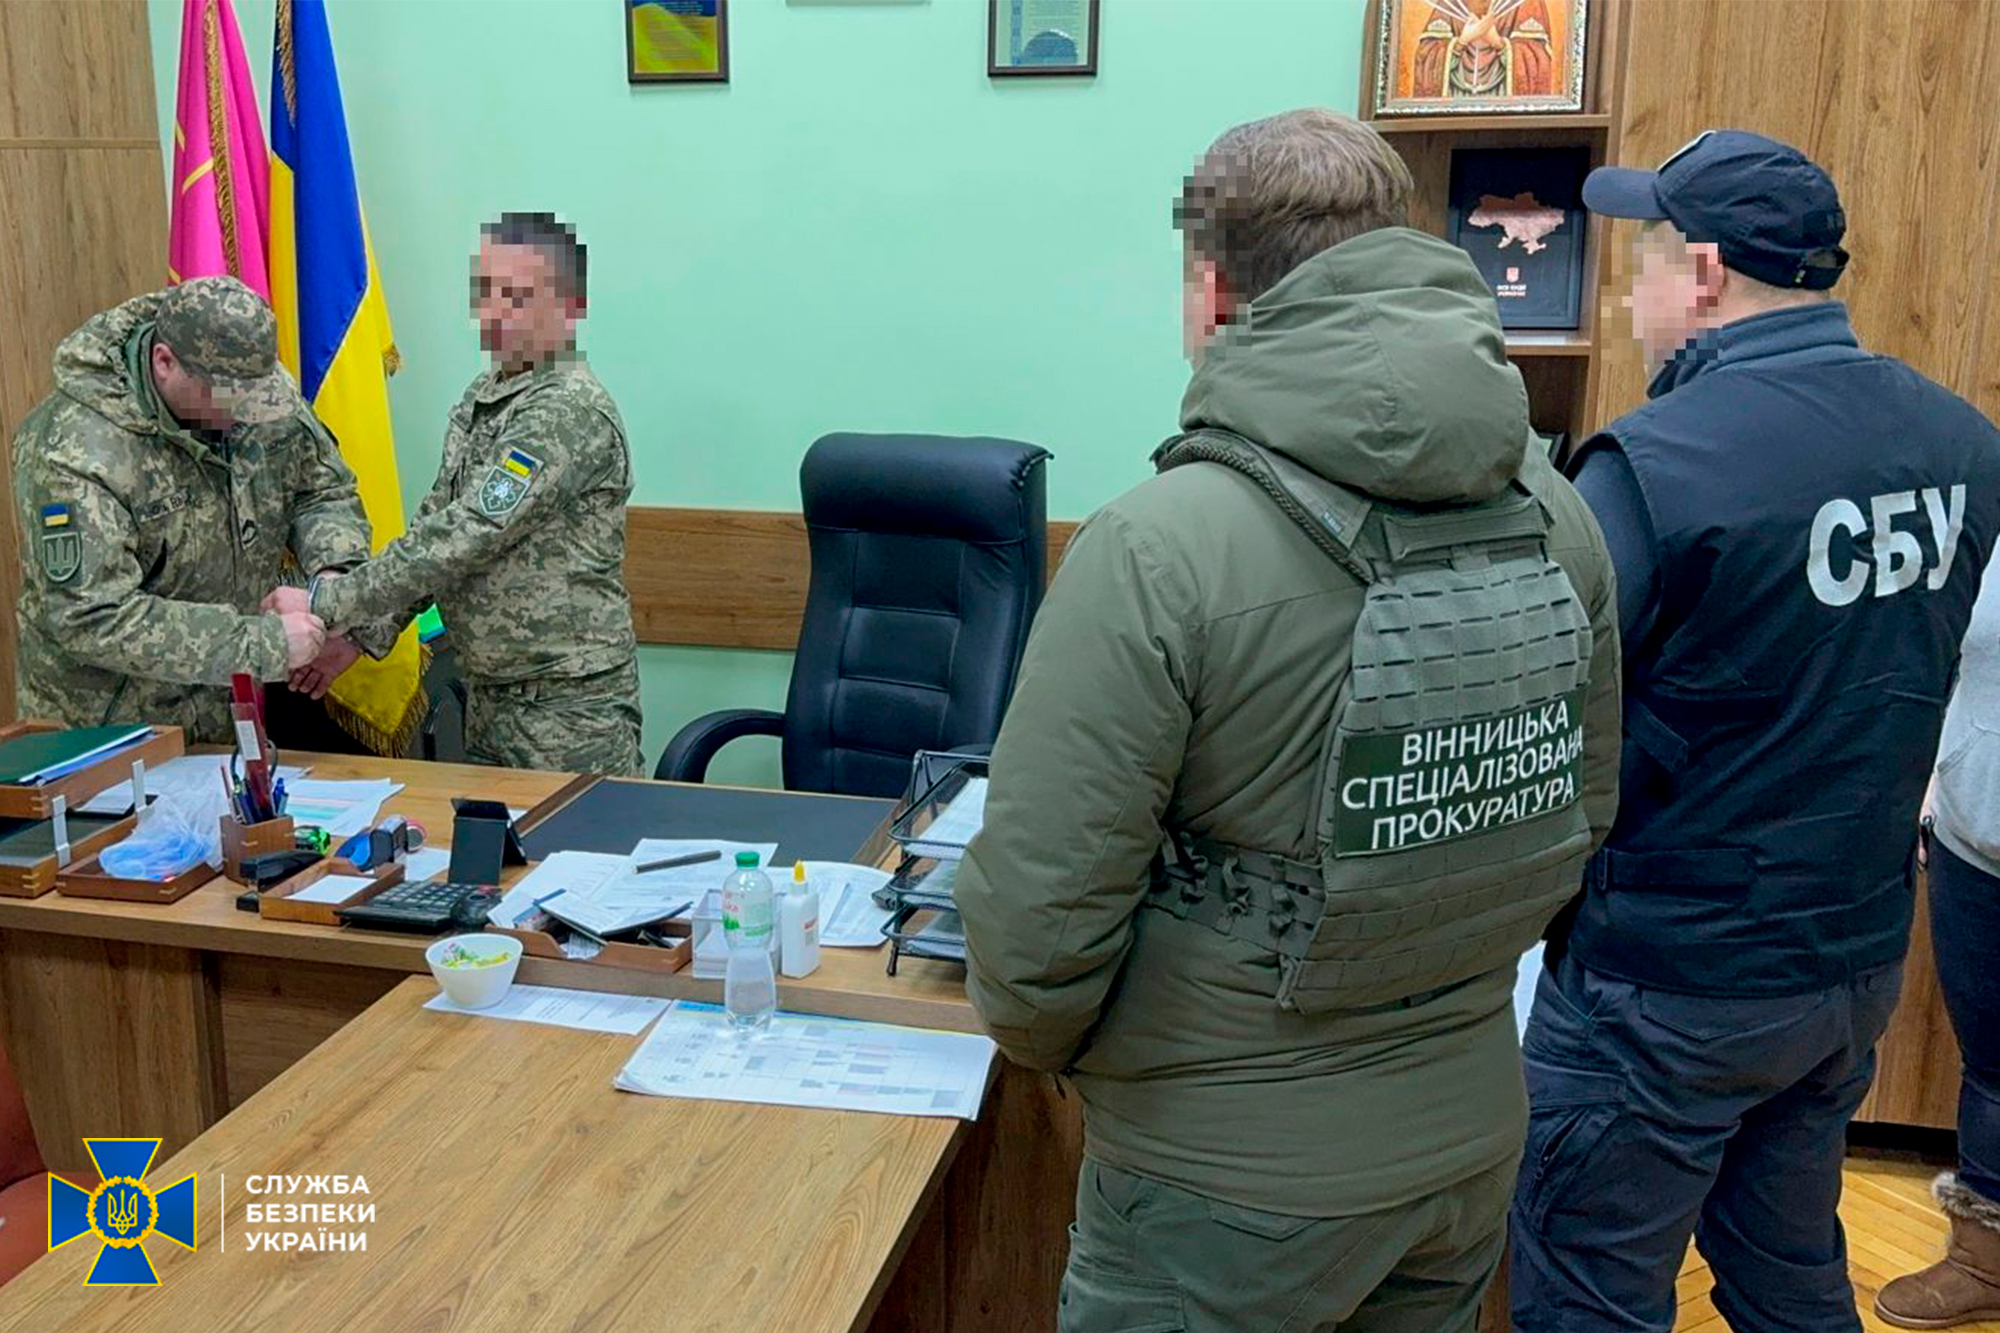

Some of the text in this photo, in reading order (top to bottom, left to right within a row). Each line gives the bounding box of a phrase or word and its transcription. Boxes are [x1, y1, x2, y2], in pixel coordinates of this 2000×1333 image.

[1806, 484, 1966, 607] СБУ
[1402, 700, 1569, 766] ВІННИЦЬКА
[1371, 772, 1575, 850] ПРОКУРАТУРА
